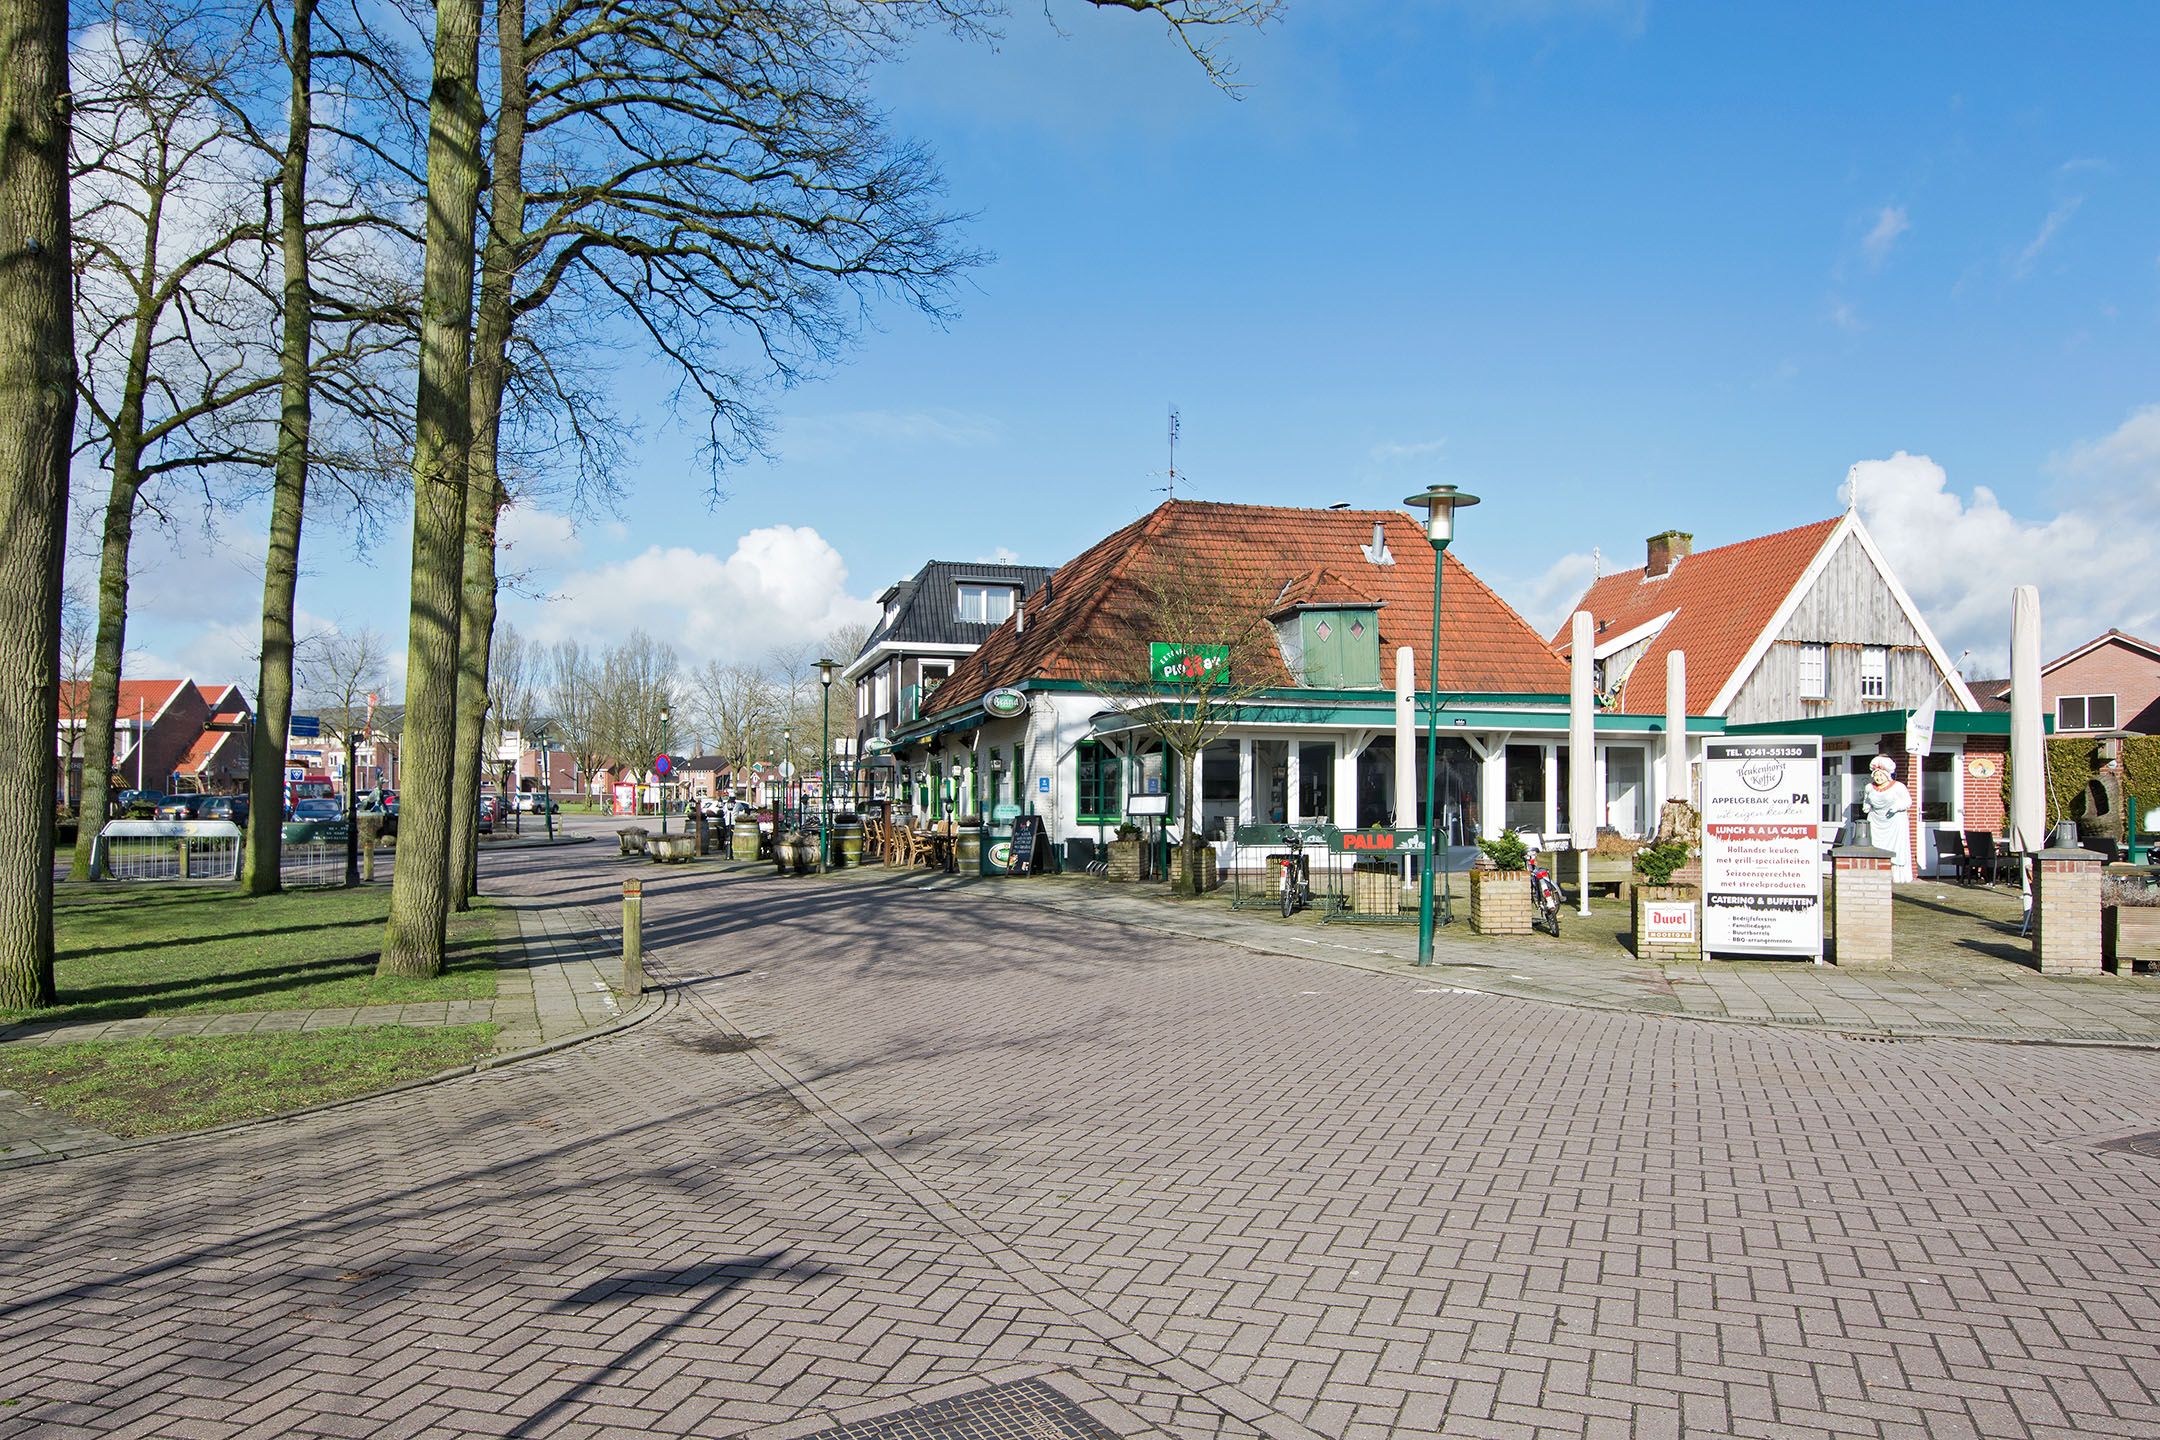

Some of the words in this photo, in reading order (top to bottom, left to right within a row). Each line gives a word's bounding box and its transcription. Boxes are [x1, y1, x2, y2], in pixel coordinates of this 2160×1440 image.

[1725, 748, 1743, 757] TEL.
[1744, 747, 1803, 757] 0541-551350
[1736, 762, 1786, 777] Beukenhorst
[1750, 774, 1776, 787] Koffie
[1711, 797, 1769, 805] APPELGEBAK
[1792, 793, 1810, 805] PA
[1715, 826, 1746, 835] LUNCH
[1748, 826, 1756, 835] &
[1757, 826, 1766, 835] A
[1767, 826, 1779, 835] LA
[1780, 826, 1808, 835] CARTE
[1343, 834, 1394, 850] PALM
[1727, 846, 1767, 854] Hollandse
[1769, 846, 1799, 854] keuken
[1734, 857, 1811, 865] grill-specialiteiten
[1725, 869, 1801, 879] Seizoensgerechten
[1739, 881, 1806, 889] streekproducten
[1711, 895, 1755, 905] CATERING
[1756, 896, 1765, 905] &
[1766, 897, 1814, 906] BUFFETTEN
[1653, 911, 1687, 925] Duvel
